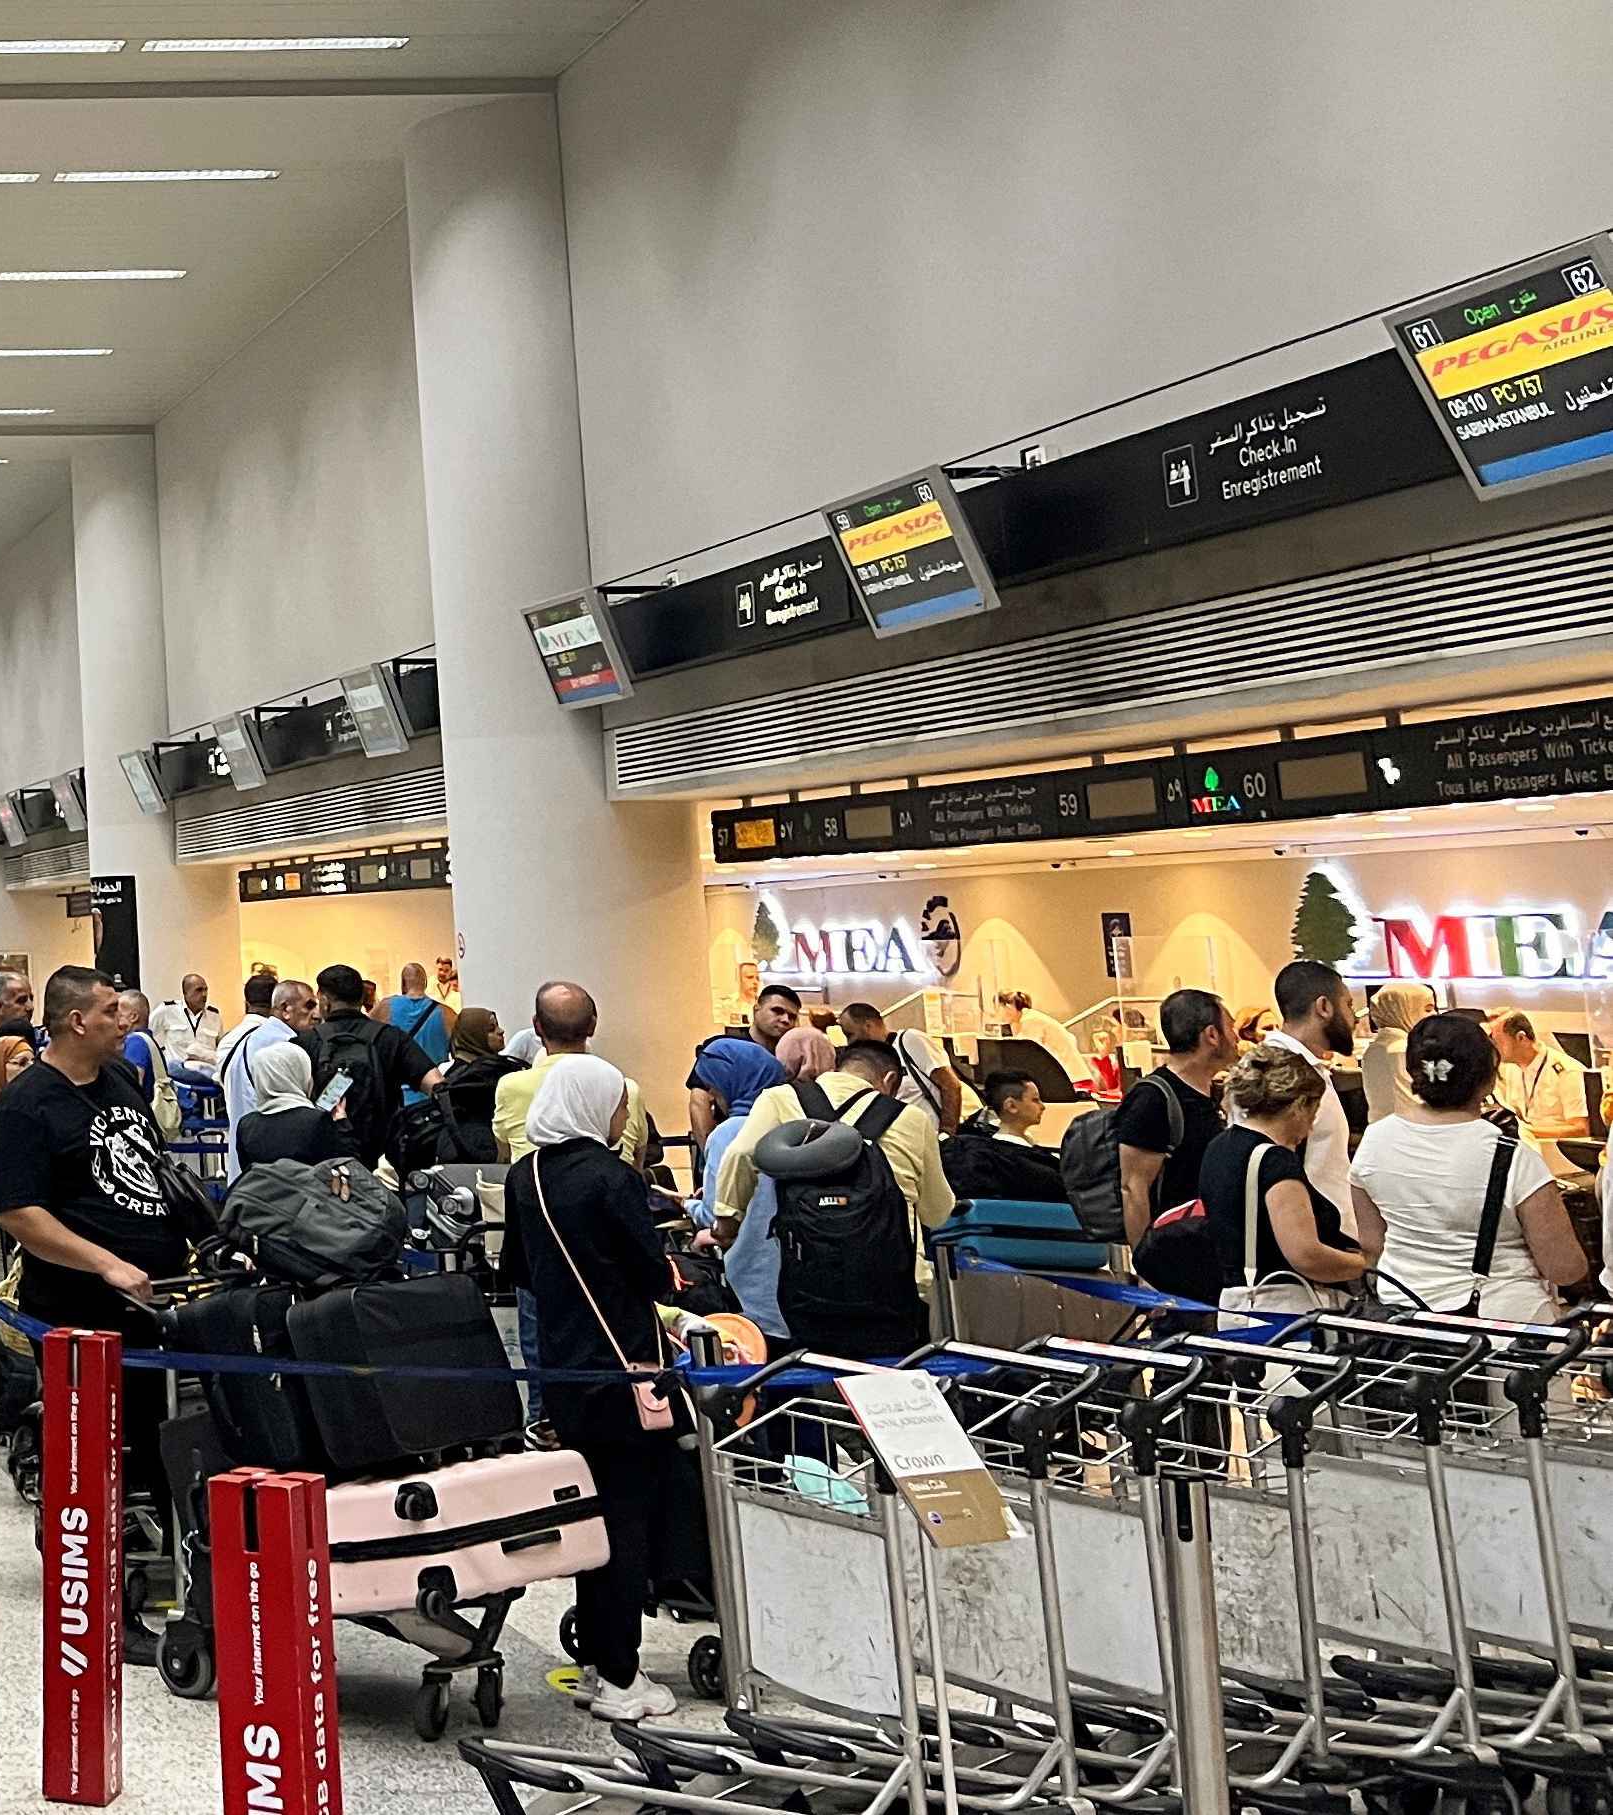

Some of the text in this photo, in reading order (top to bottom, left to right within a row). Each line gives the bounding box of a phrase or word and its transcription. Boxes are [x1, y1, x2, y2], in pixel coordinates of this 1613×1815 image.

[1570, 266, 1601, 293] 62
[1463, 302, 1502, 326] Open
[1411, 324, 1436, 349] 61
[1432, 303, 1613, 377] PEGASUS
[1447, 392, 1488, 420] 09:10
[1491, 387, 1517, 406] PC
[1518, 375, 1544, 398] 757
[1208, 397, 1326, 455] تسجيل تذاكر السفر
[1239, 435, 1297, 467] Check-In
[1222, 455, 1322, 500] Enregistrement
[918, 484, 933, 502] 60
[848, 511, 943, 551] PEGASUS
[1499, 721, 1537, 743] حاملي
[1539, 710, 1601, 738] المسافرين
[1447, 752, 1463, 769] All
[1469, 748, 1539, 768] Passengers
[1544, 741, 1575, 759] With
[1166, 778, 1183, 802] ٥٩
[1243, 772, 1267, 798] 60
[1436, 780, 1465, 797] Tous
[1470, 778, 1489, 794] les
[1494, 771, 1557, 792] Passagers
[1564, 767, 1597, 785] Avec
[1058, 793, 1078, 816] 59
[1191, 795, 1241, 814] MEA
[717, 828, 729, 846] 57
[824, 818, 838, 837] 58
[790, 927, 915, 973] MEA
[1370, 911, 1613, 979] ME
[70, 1391, 79, 1406] go
[70, 1406, 78, 1421] the
[70, 1422, 78, 1436] on
[894, 1453, 947, 1471] Crown
[70, 1475, 79, 1495] Your
[60, 1507, 88, 1635] USIMS
[307, 1558, 320, 1628] free
[248, 1562, 265, 1706] Your internet on the go
[310, 1635, 323, 1684] for
[70, 1688, 79, 1702] go
[70, 1703, 78, 1720] the
[314, 1692, 326, 1770] data
[70, 1774, 79, 1796] Your
